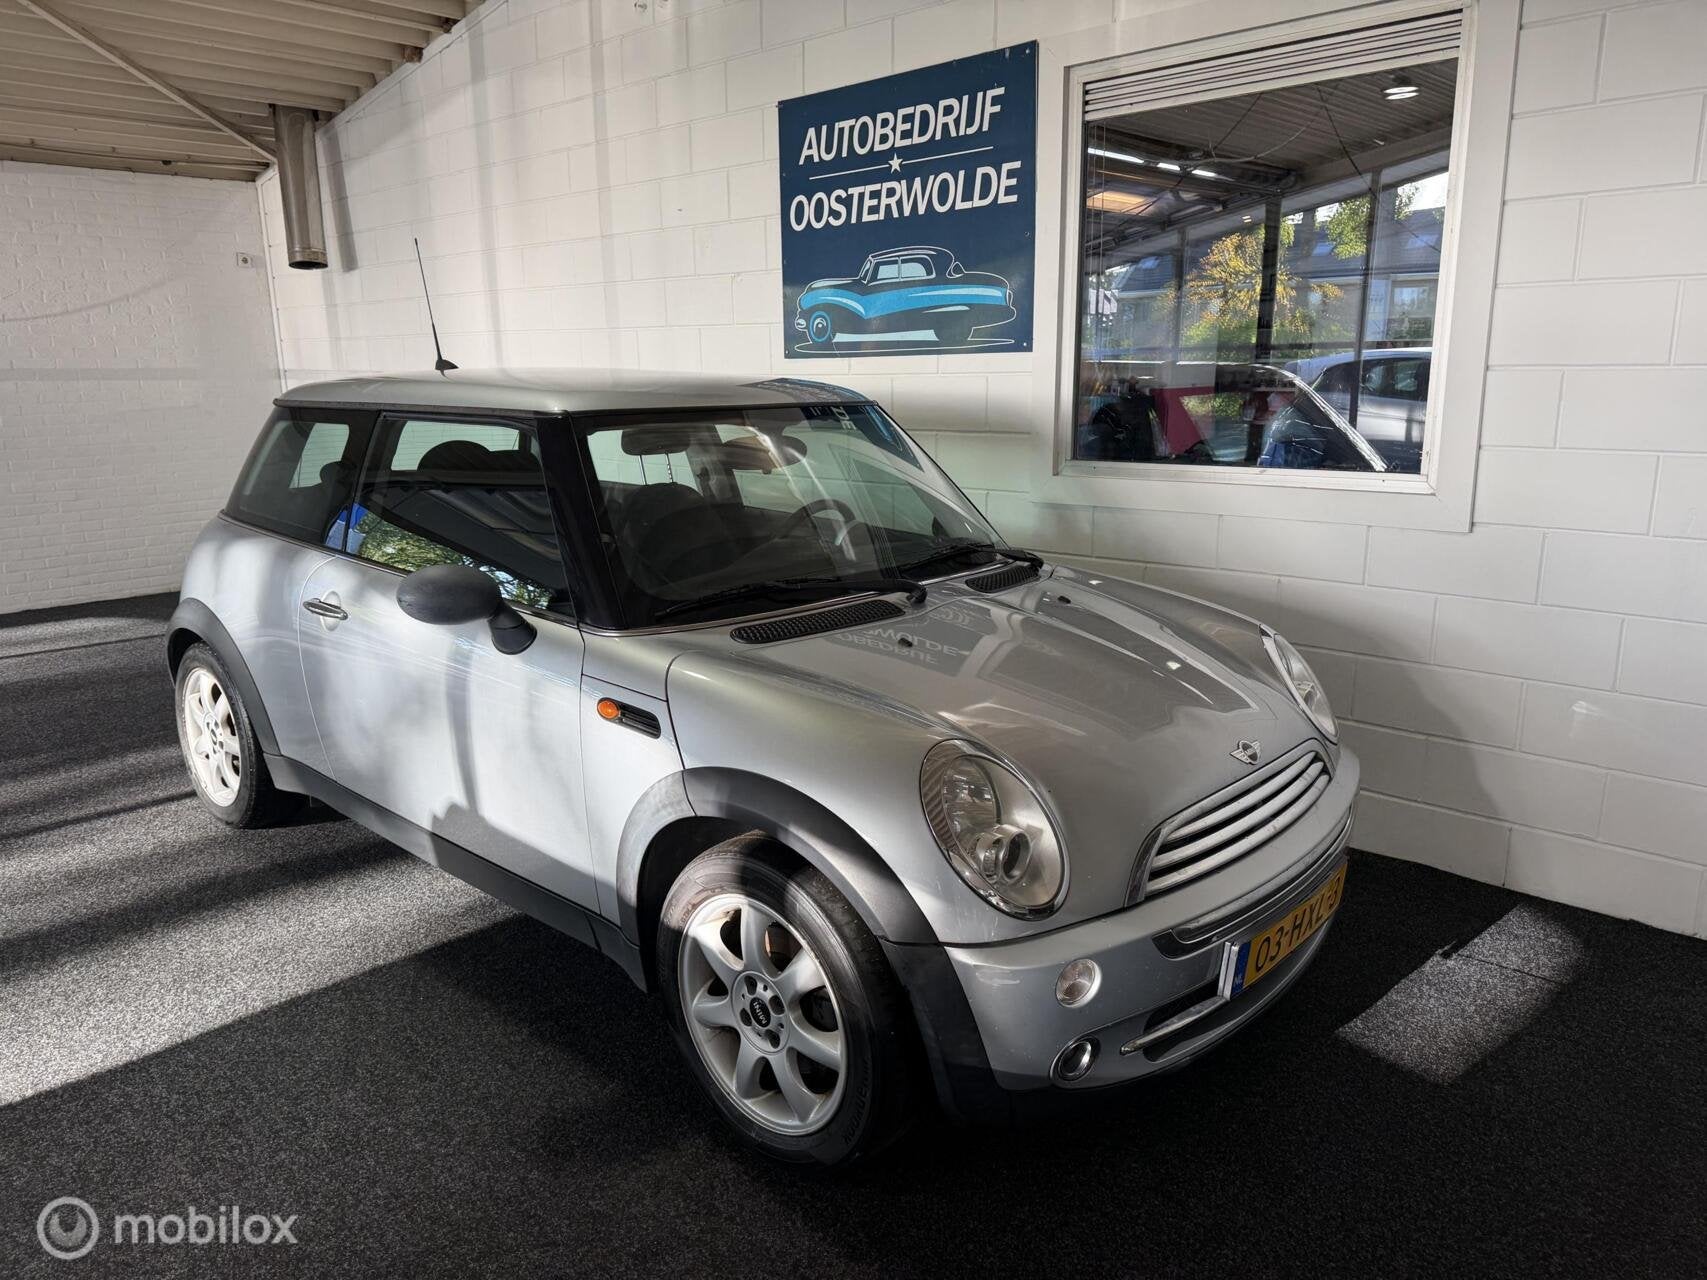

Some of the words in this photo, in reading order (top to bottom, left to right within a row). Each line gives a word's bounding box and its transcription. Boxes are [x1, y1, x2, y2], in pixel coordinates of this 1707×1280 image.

[799, 86, 1005, 166] AUTOBEDRIJF
[789, 160, 1022, 232] OOSTERWOLDE
[752, 1001, 768, 1025] MINI
